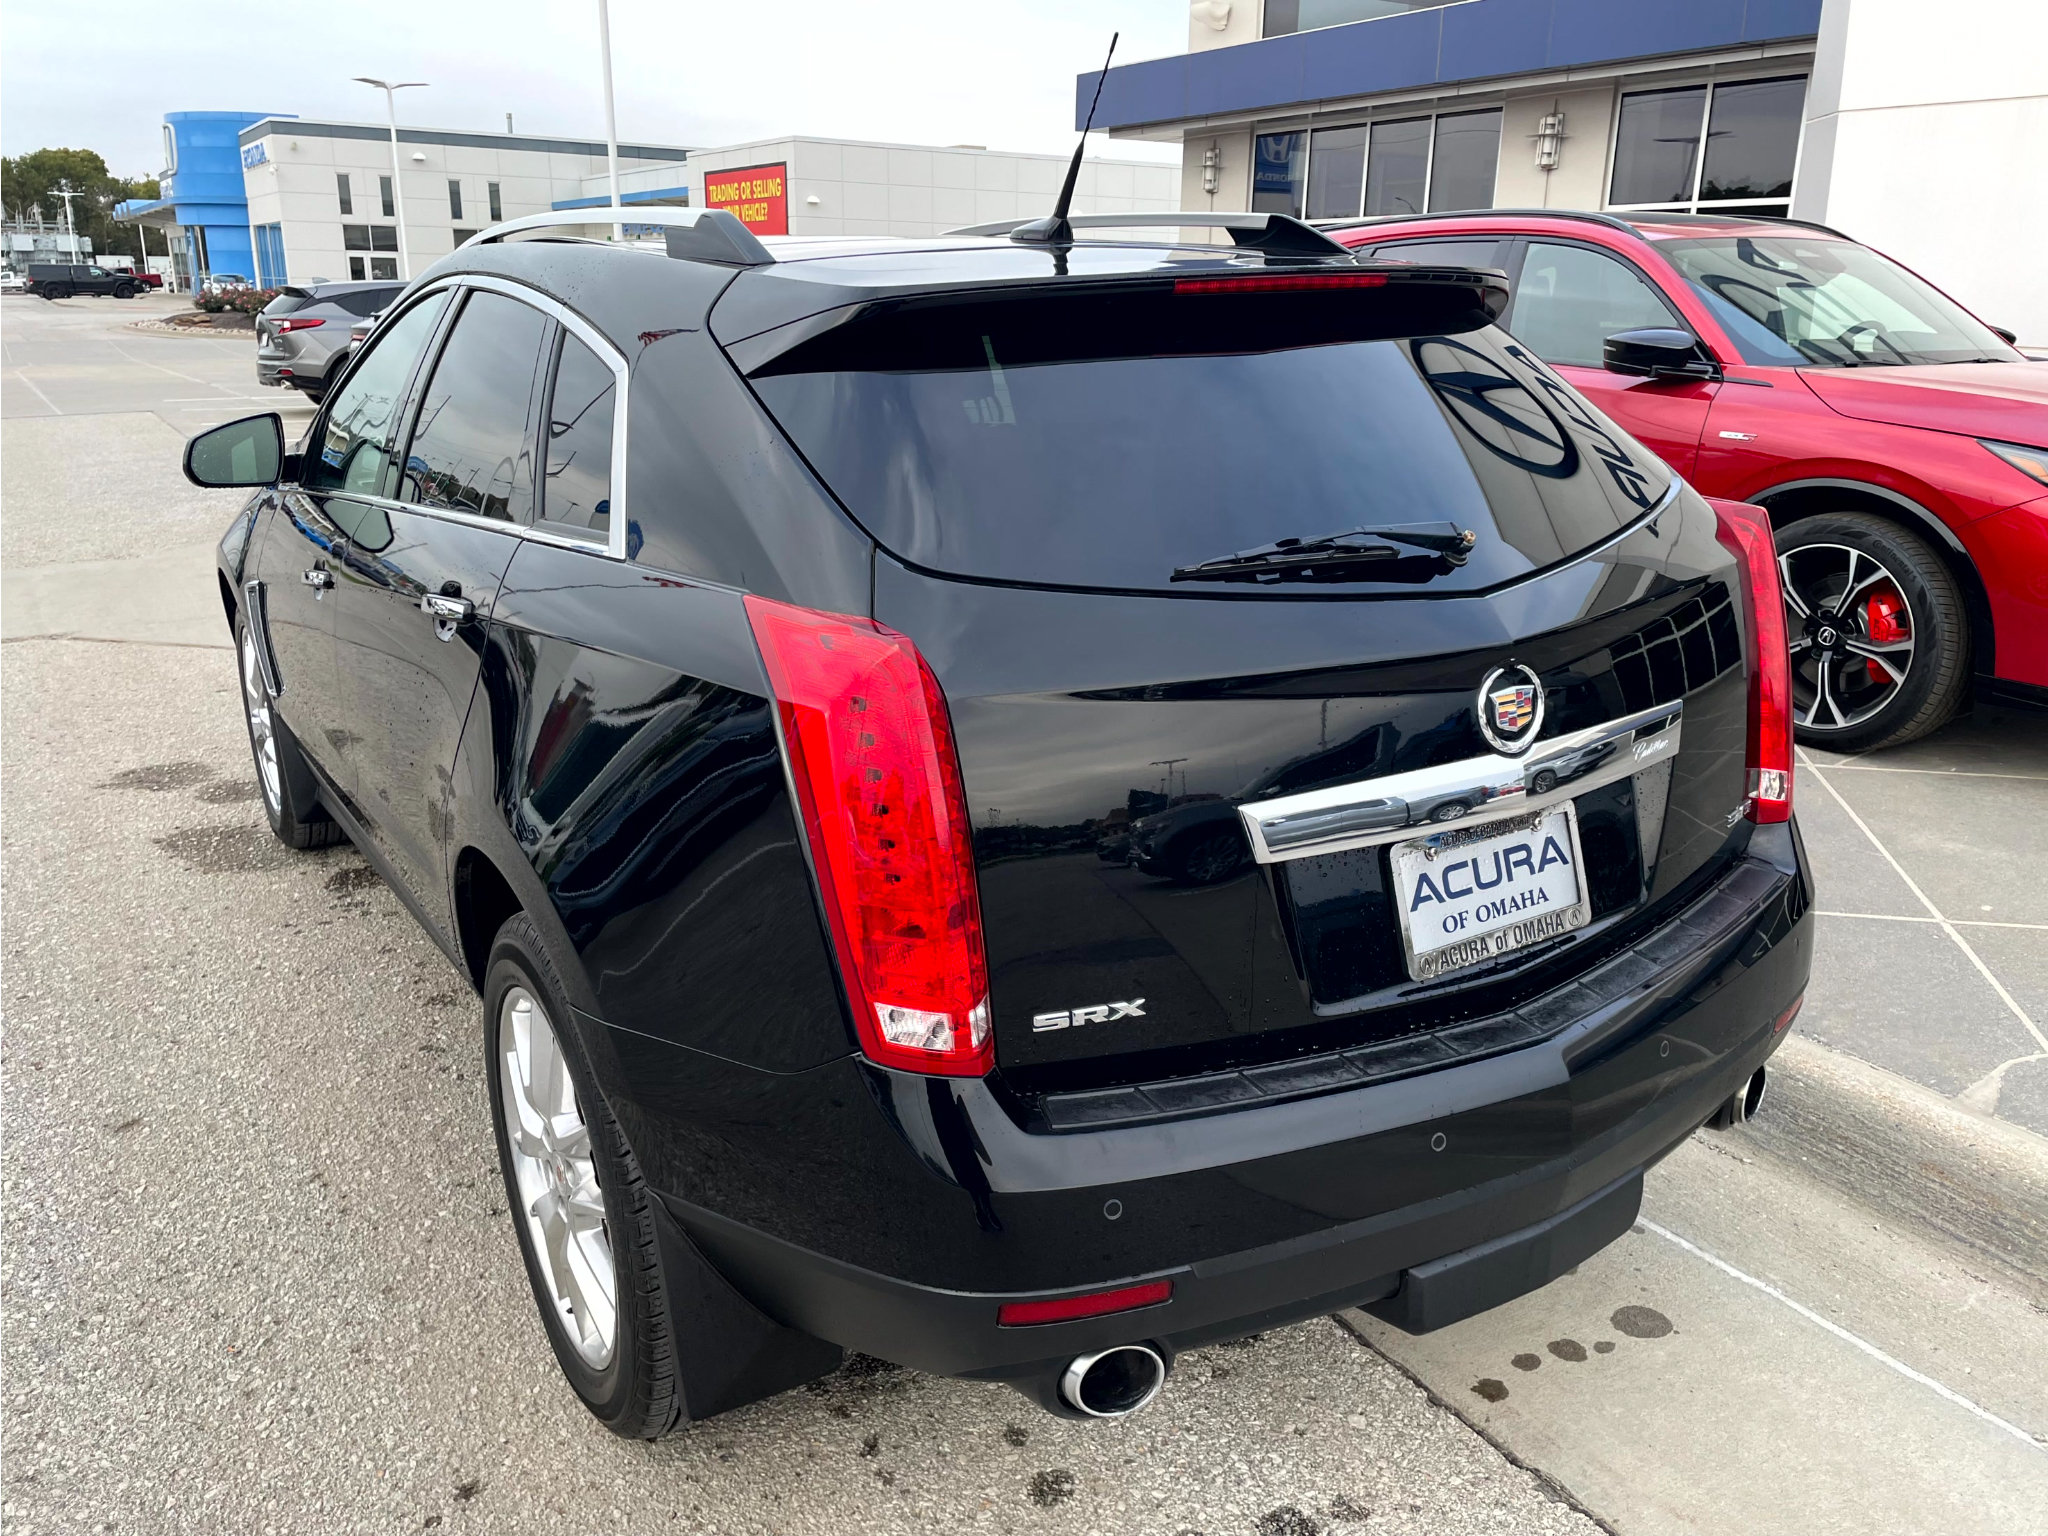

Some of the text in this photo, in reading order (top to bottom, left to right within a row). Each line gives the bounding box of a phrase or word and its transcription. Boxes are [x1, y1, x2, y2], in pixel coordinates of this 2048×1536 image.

[709, 178, 782, 203] TRADING OR SELLING
[741, 202, 768, 222] VEHICLE?
[1872, 539, 1914, 577] Continental
[1410, 836, 1569, 912] ACURA
[1442, 886, 1550, 934] OF OMAHA
[1440, 913, 1565, 970] ACURA of OMAHA
[1032, 998, 1147, 1033] SRX
